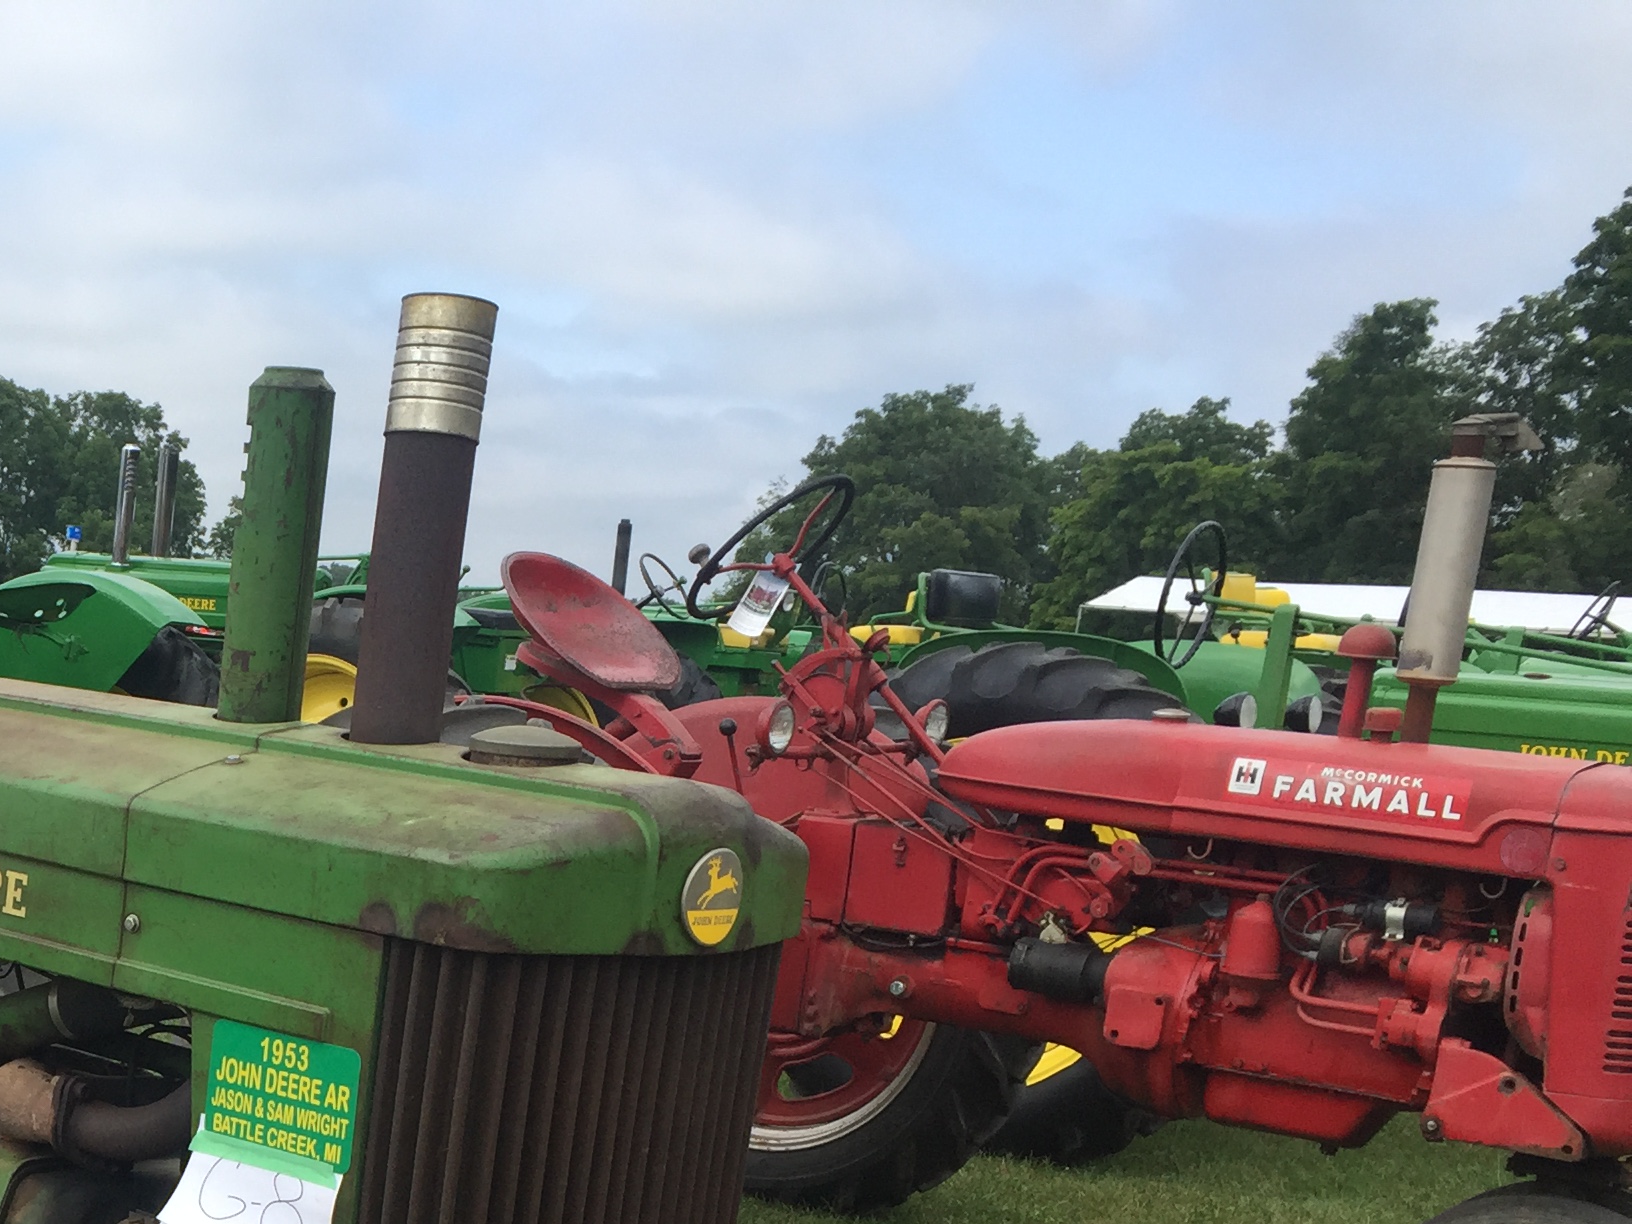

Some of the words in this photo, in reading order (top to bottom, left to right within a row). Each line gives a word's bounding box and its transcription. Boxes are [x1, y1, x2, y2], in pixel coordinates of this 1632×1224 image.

[179, 597, 216, 611] DEERE
[1272, 775, 1462, 821] FARMALL
[261, 1037, 309, 1071] 1953
[216, 1056, 262, 1090] JOHN
[265, 1067, 323, 1106] DEERE
[324, 1083, 350, 1113] AR
[211, 1086, 253, 1114] JASON
[255, 1097, 264, 1118] &
[267, 1100, 294, 1126] SAM
[297, 1107, 349, 1140] WRIGHT
[212, 1113, 264, 1143] BATTLE
[267, 1127, 320, 1161] CREEK,
[324, 1142, 342, 1164] MI
